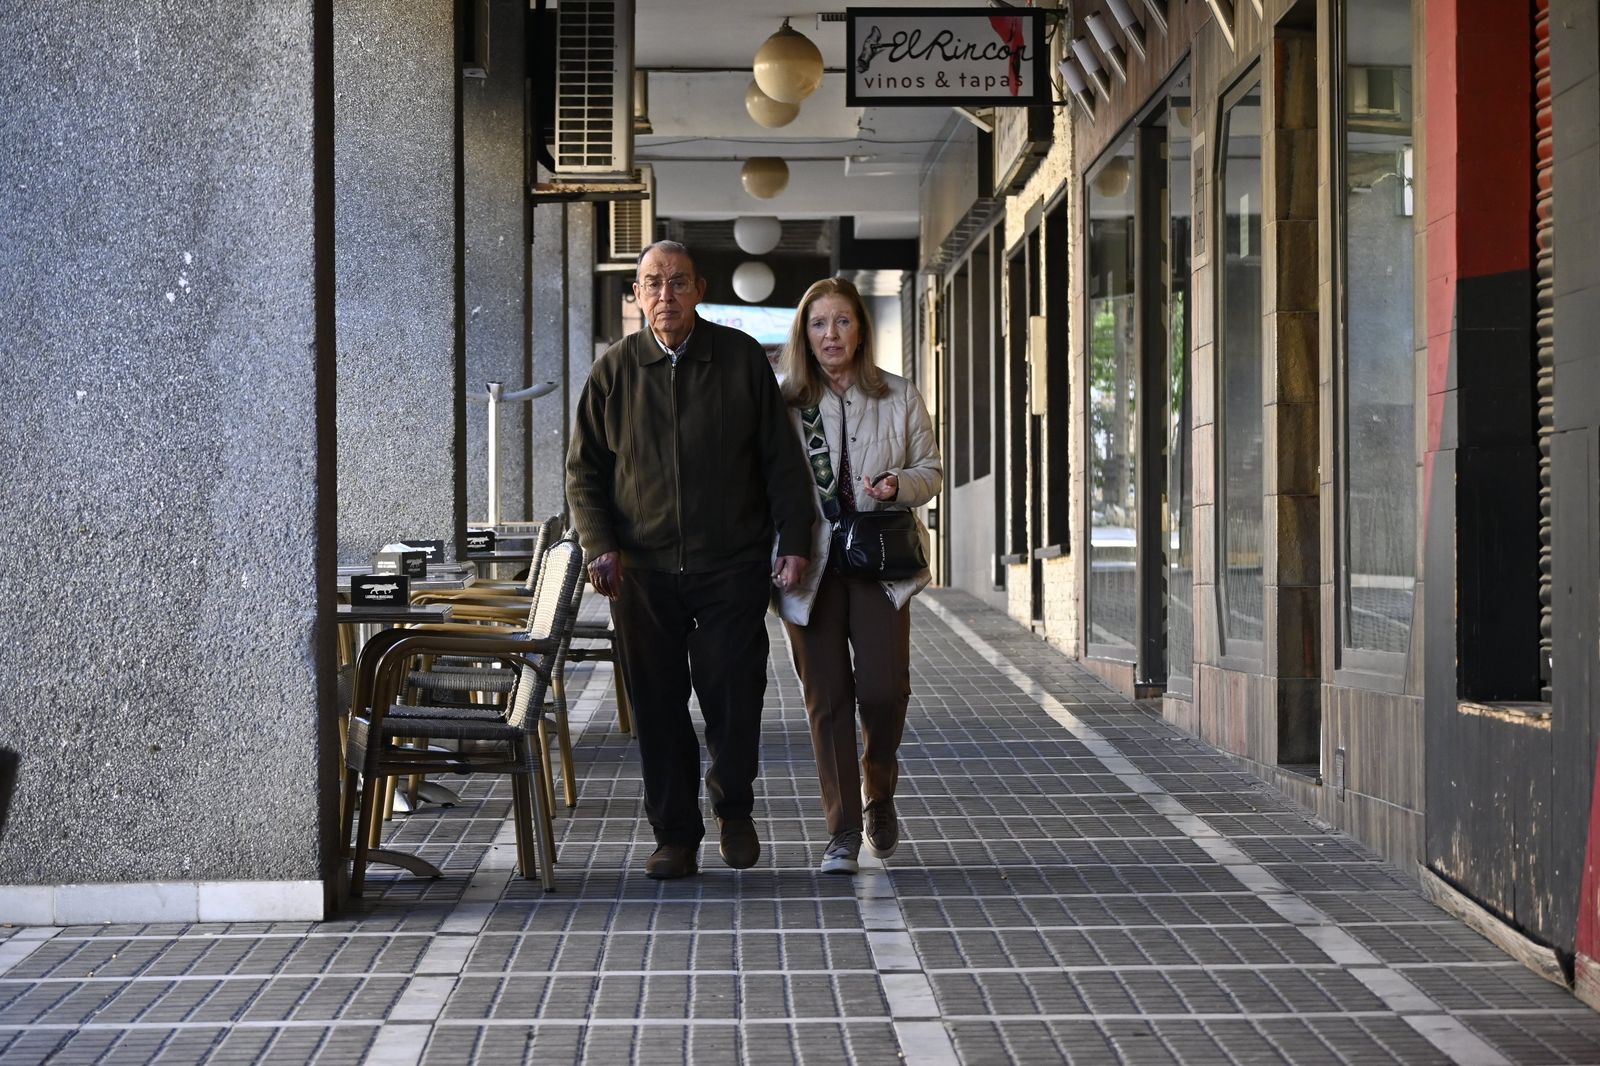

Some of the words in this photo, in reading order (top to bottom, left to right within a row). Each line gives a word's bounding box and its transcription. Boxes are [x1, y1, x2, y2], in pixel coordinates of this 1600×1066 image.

[888, 29, 922, 62] El
[864, 73, 925, 88] vinos
[935, 71, 951, 88] &
[959, 72, 1023, 91] tapas
